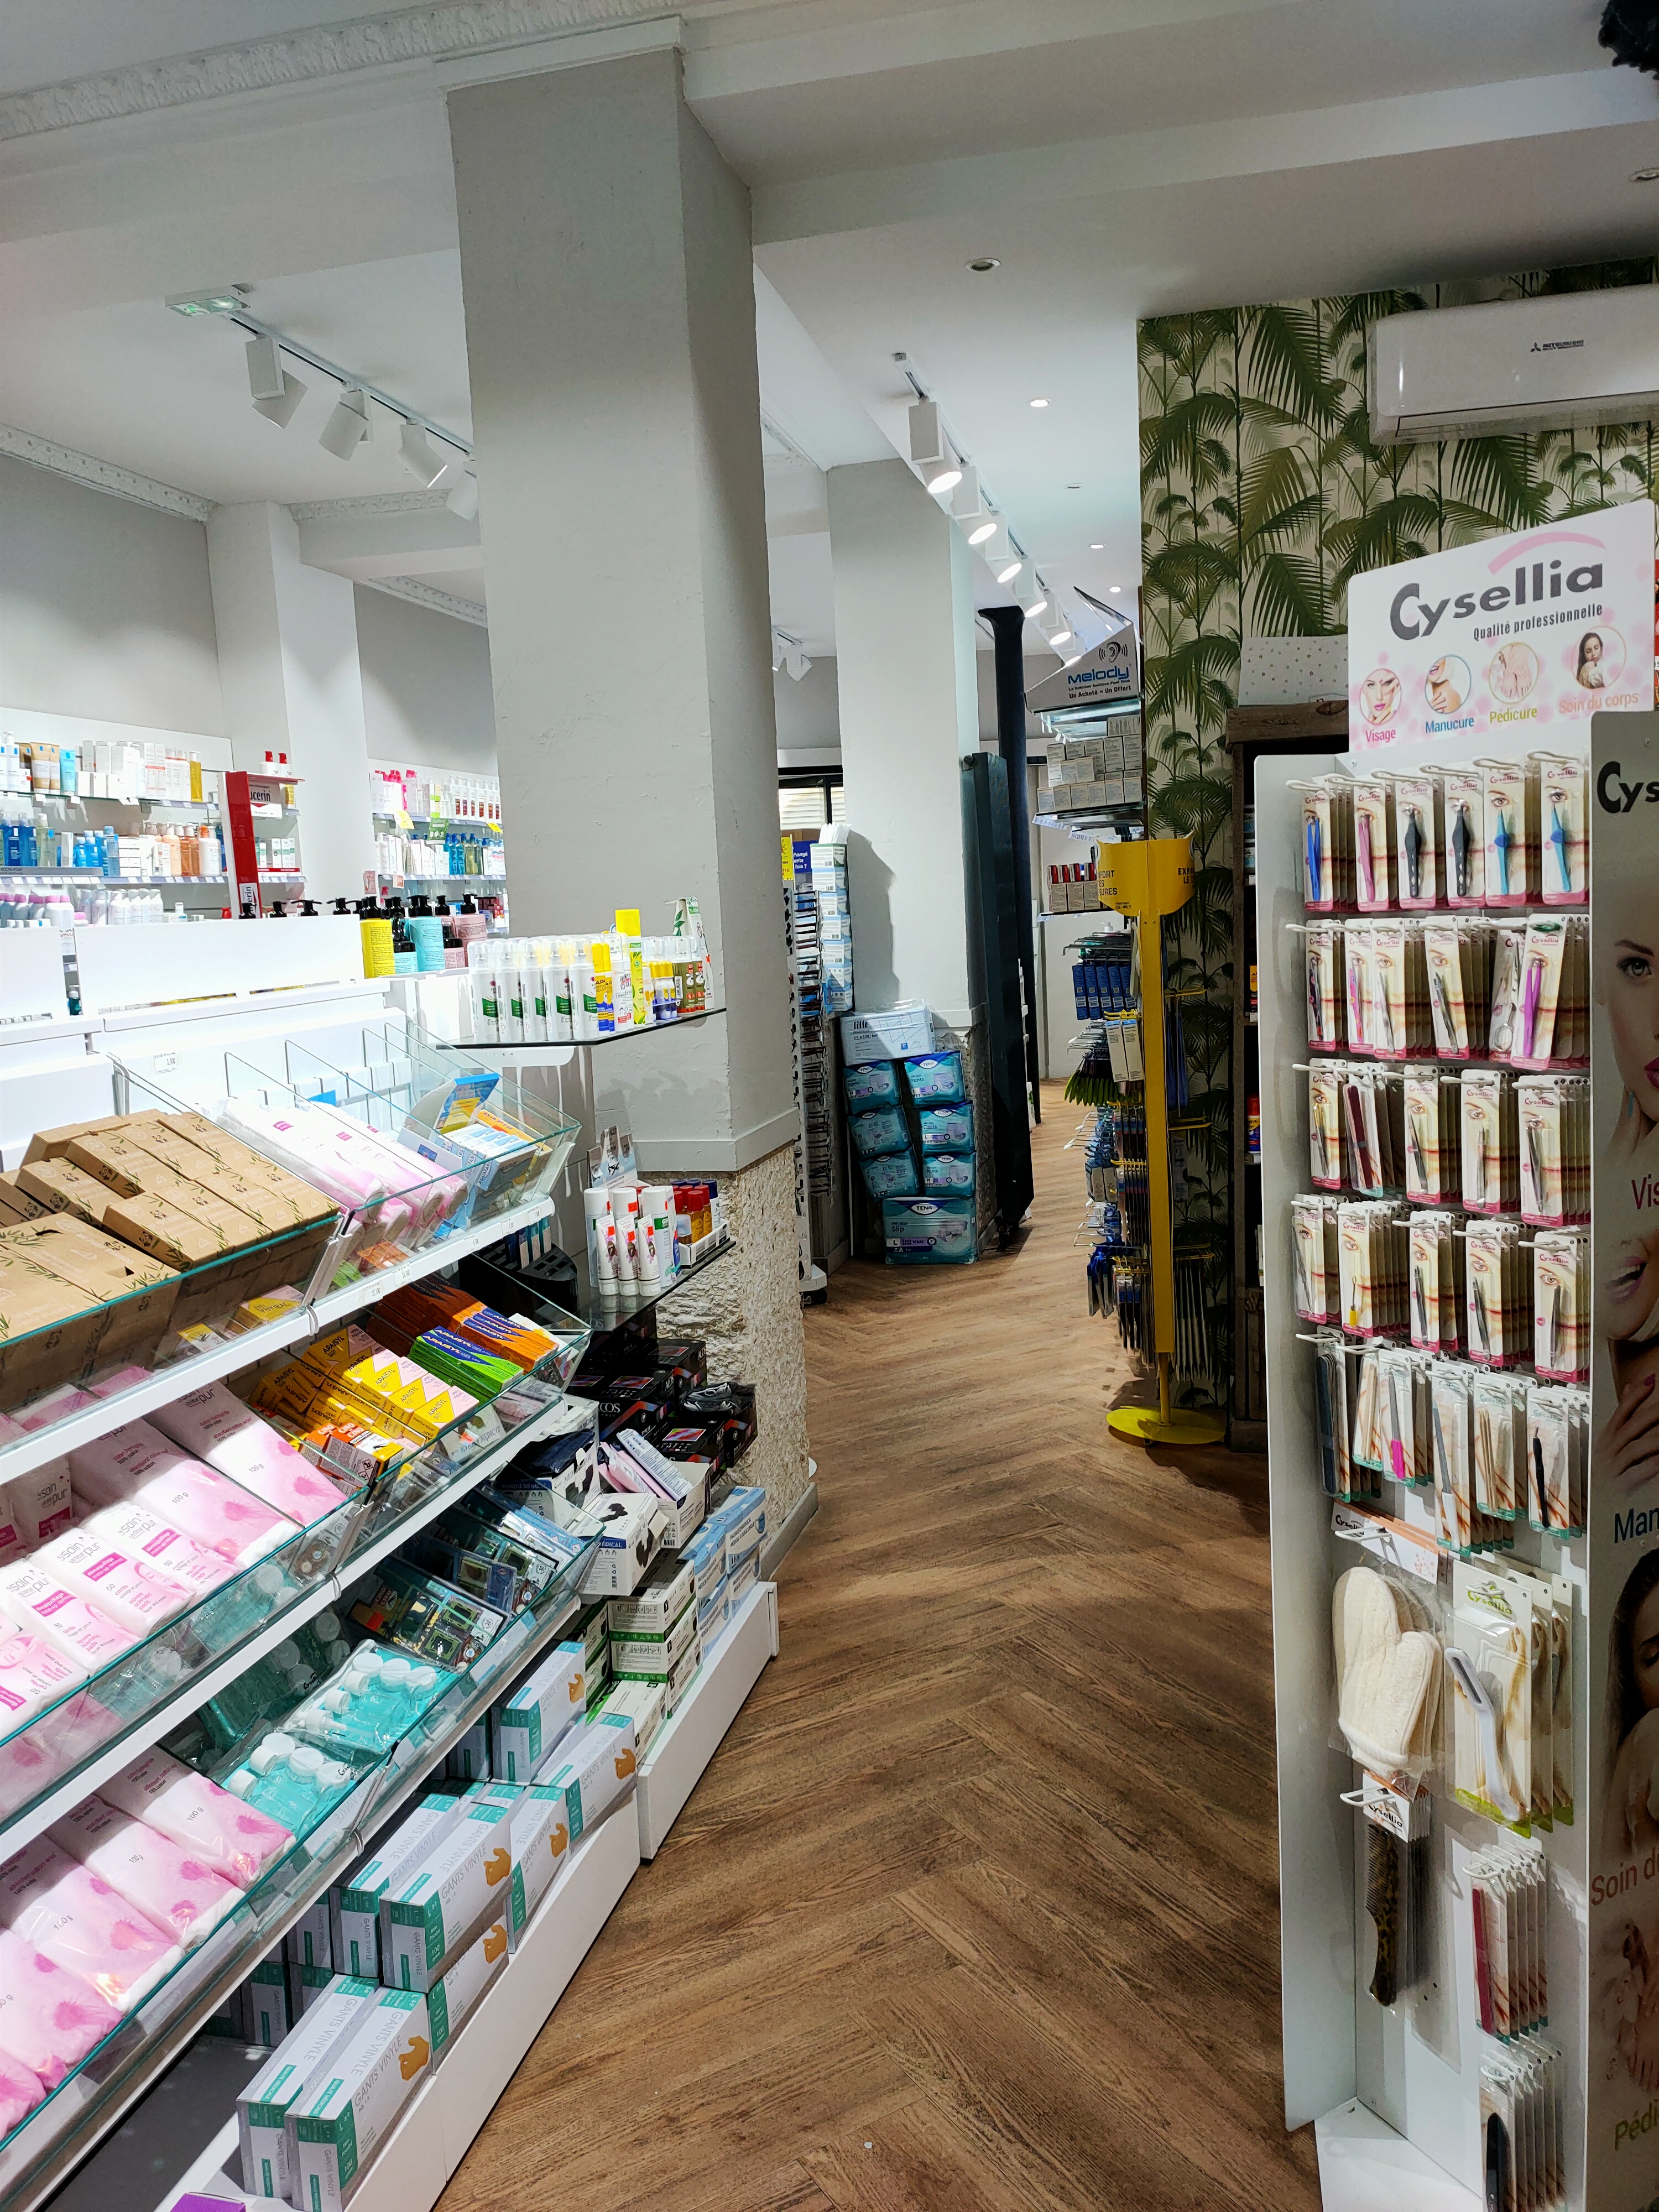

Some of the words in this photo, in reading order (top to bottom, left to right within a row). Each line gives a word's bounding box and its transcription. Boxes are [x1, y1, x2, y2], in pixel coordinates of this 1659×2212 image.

[1390, 560, 1603, 640] Cysellia
[1473, 620, 1510, 641] Qualité
[1514, 604, 1603, 634] professionnelle
[1068, 665, 1129, 684] Melody
[1559, 697, 1586, 714] Soin
[1588, 695, 1603, 709] du
[1605, 692, 1639, 708] corps
[1489, 706, 1538, 724] Pédicure
[1365, 728, 1396, 743] Visage
[1425, 717, 1474, 734] Manucure
[322, 1335, 345, 1354] APAISYL
[422, 1335, 461, 1354] APAISYL
[375, 1368, 395, 1385] APAISYL
[400, 1386, 419, 1402] APAISYL
[427, 1398, 447, 1417] APAISYL
[599, 1403, 620, 1413] COS
[172, 1495, 183, 1504] 100
[61, 1542, 84, 1558] soin
[85, 1542, 101, 1556] pur
[10, 1574, 34, 1591] soin
[187, 1810, 198, 1822] 100
[531, 1801, 551, 1823] GANTS
[413, 1812, 439, 1834] GANTS
[516, 1821, 538, 1844] VINYLE
[462, 1823, 489, 1849] GANTS
[389, 1835, 414, 1860] VINYLE
[129, 1855, 139, 1864] 100
[440, 1847, 465, 1872] VINYLE
[442, 1870, 465, 1900] GANTS
[465, 1843, 488, 1872] VINYLE
[1591, 1863, 1637, 1905] Soin
[1644, 1846, 1659, 1880] d
[330, 1999, 358, 2027] GANTS
[375, 2012, 403, 2041] GANTS
[304, 2031, 336, 2061] VINYLE
[351, 2044, 379, 2075] VINYLE
[355, 2070, 379, 2106] GANTS
[378, 2035, 401, 2072] VINYLE
